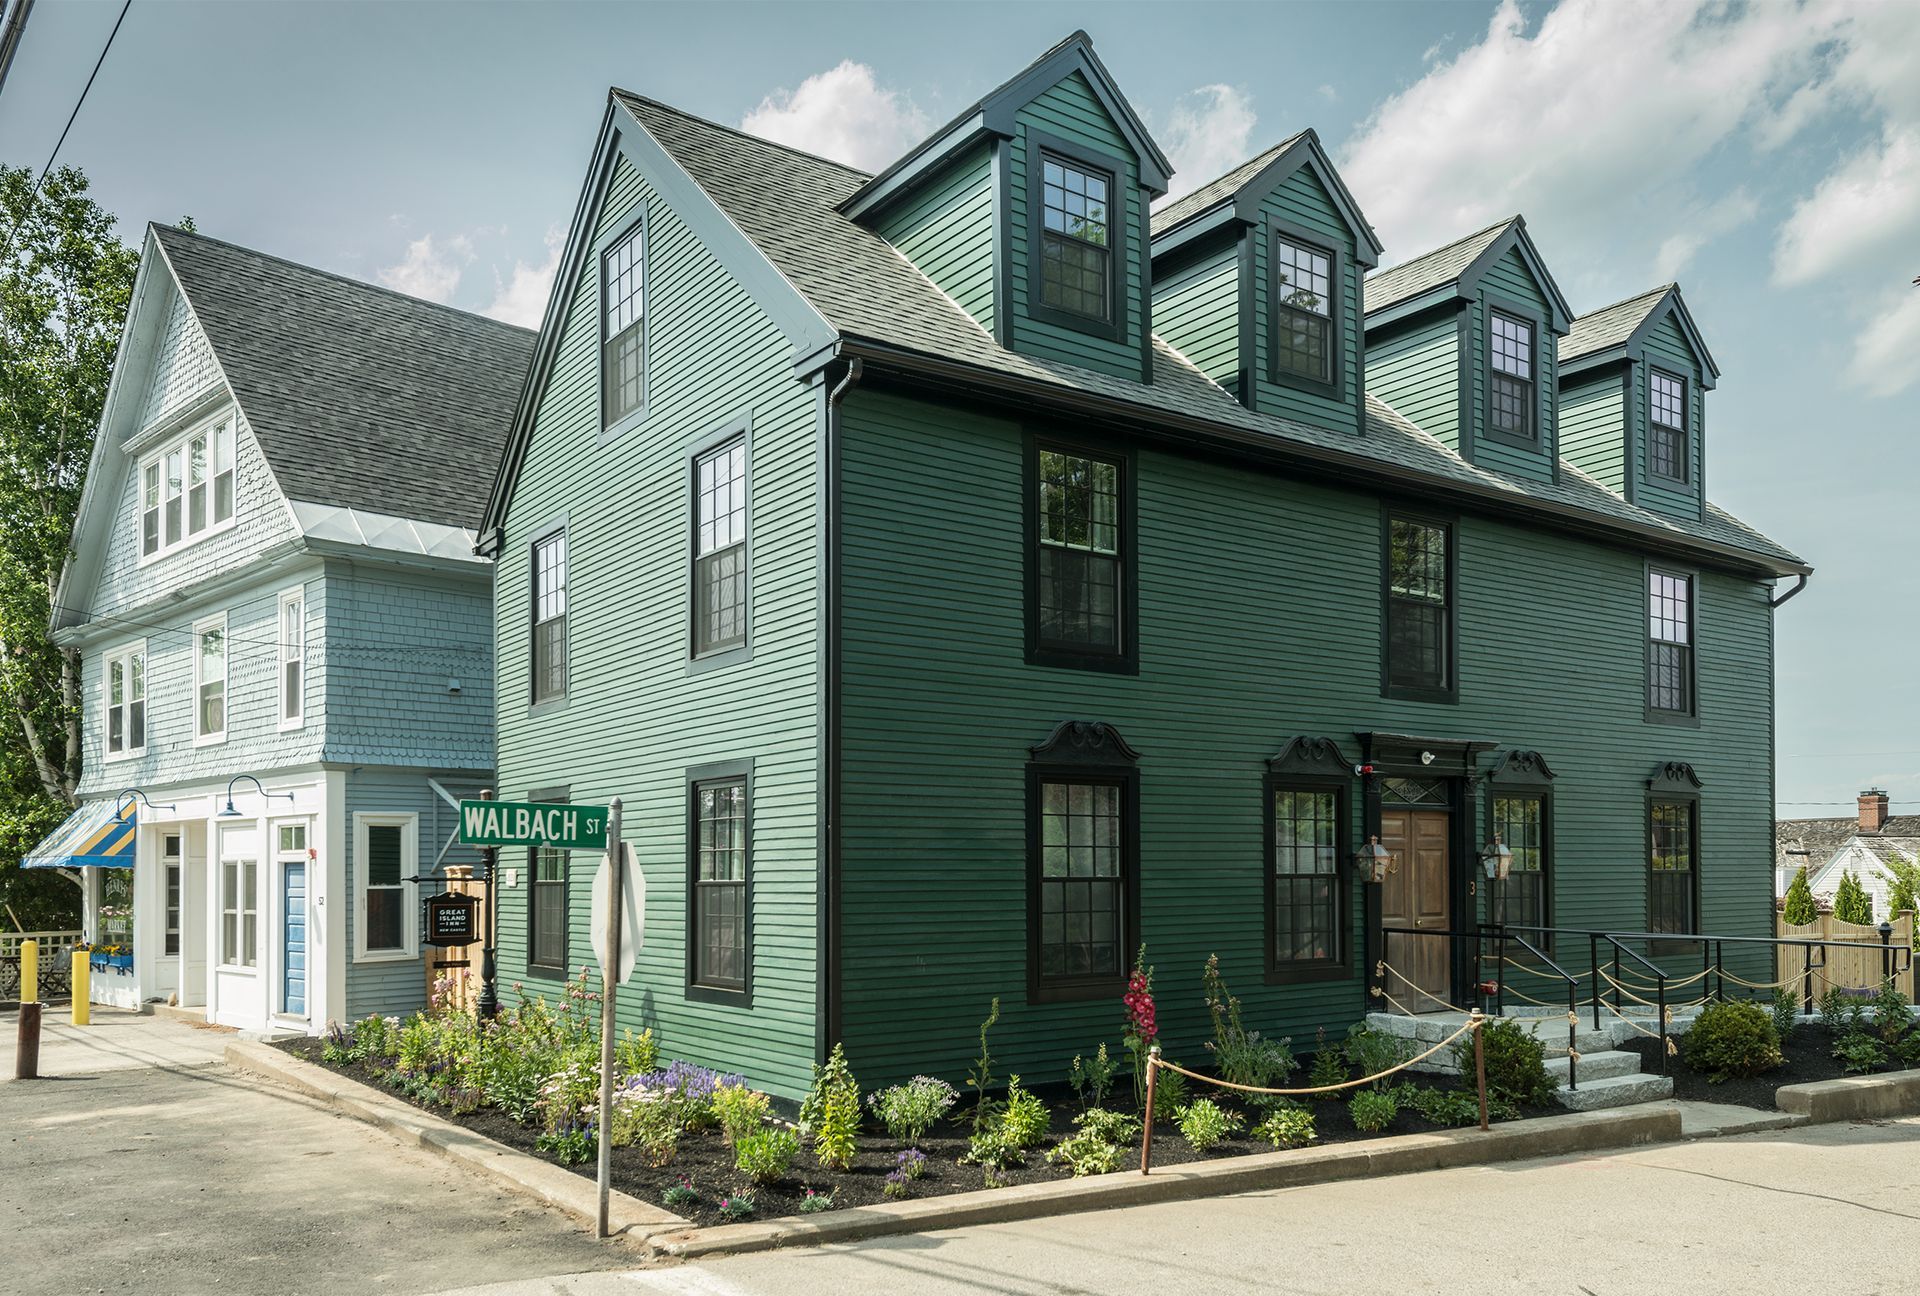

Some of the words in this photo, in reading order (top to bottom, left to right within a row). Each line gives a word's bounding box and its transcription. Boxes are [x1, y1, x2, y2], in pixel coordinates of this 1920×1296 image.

[464, 807, 577, 841] WALBACH
[586, 818, 600, 835] ST
[1470, 881, 1476, 896] 3
